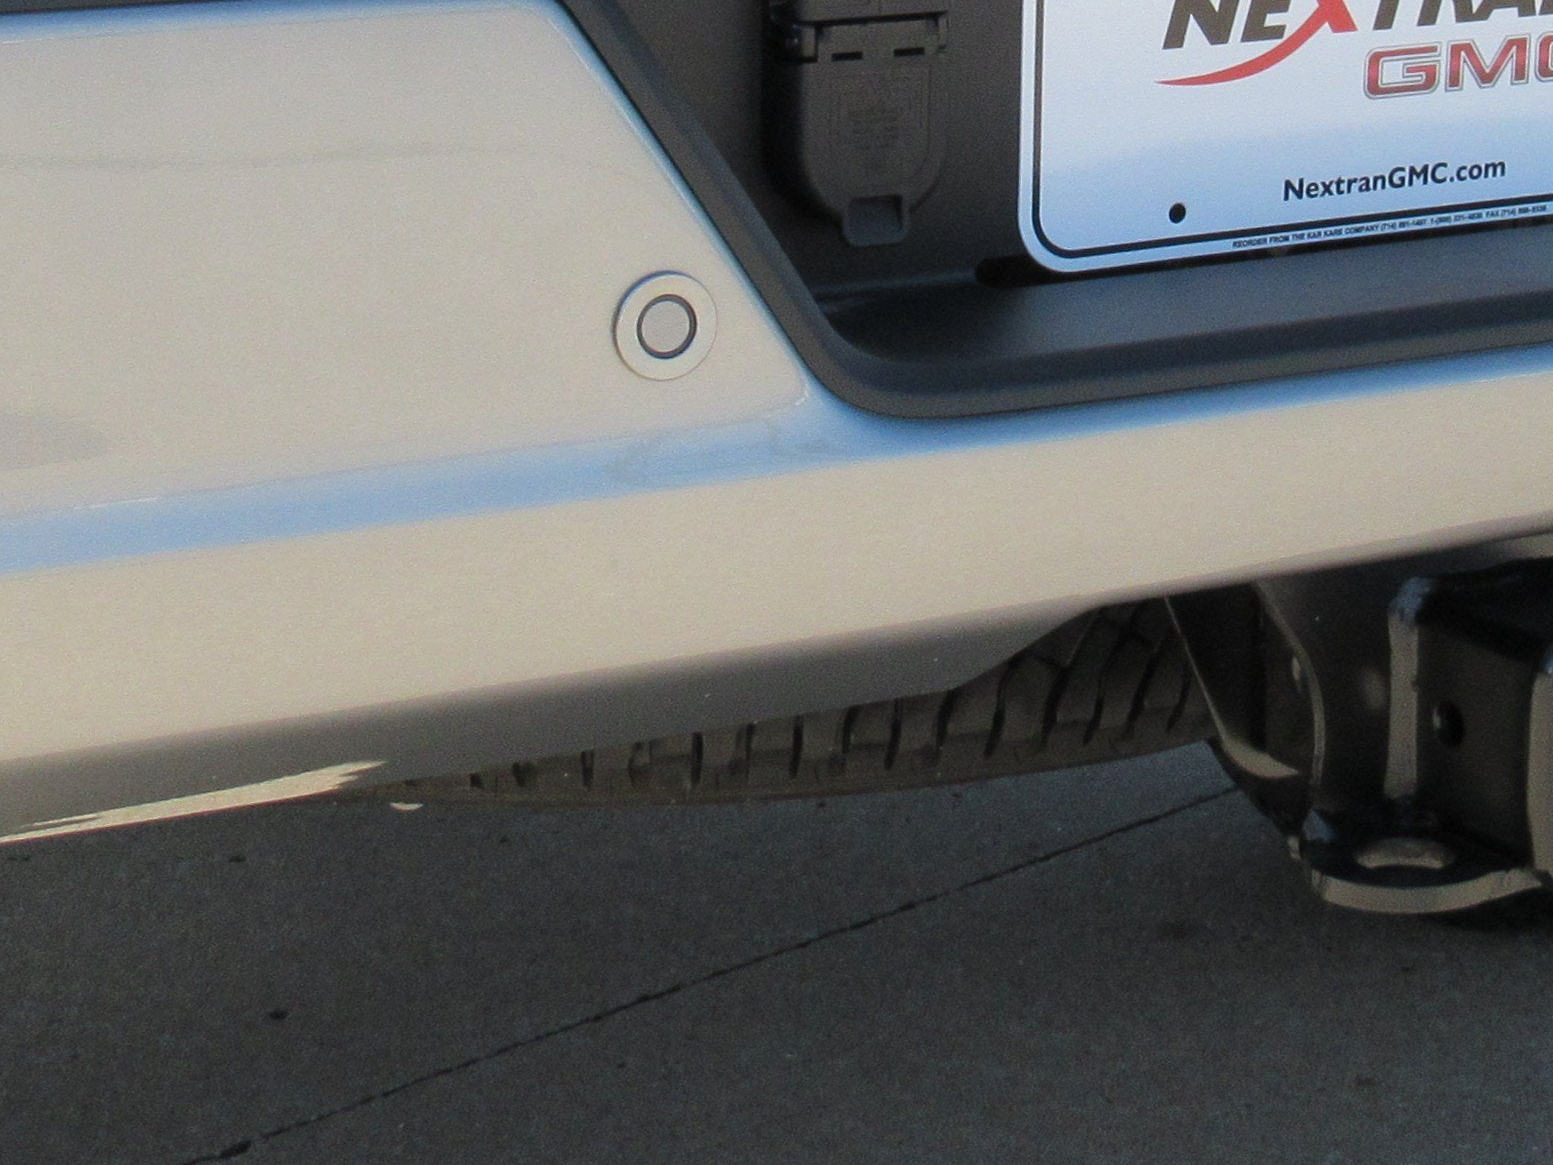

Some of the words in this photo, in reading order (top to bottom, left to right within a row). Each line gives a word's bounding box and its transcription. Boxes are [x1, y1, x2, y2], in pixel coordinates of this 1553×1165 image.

[1283, 161, 1505, 201] NextranGMC.com
[1268, 234, 1290, 245] FROM
[1291, 232, 1306, 242] THE
[1344, 225, 1380, 236] COMPANY
